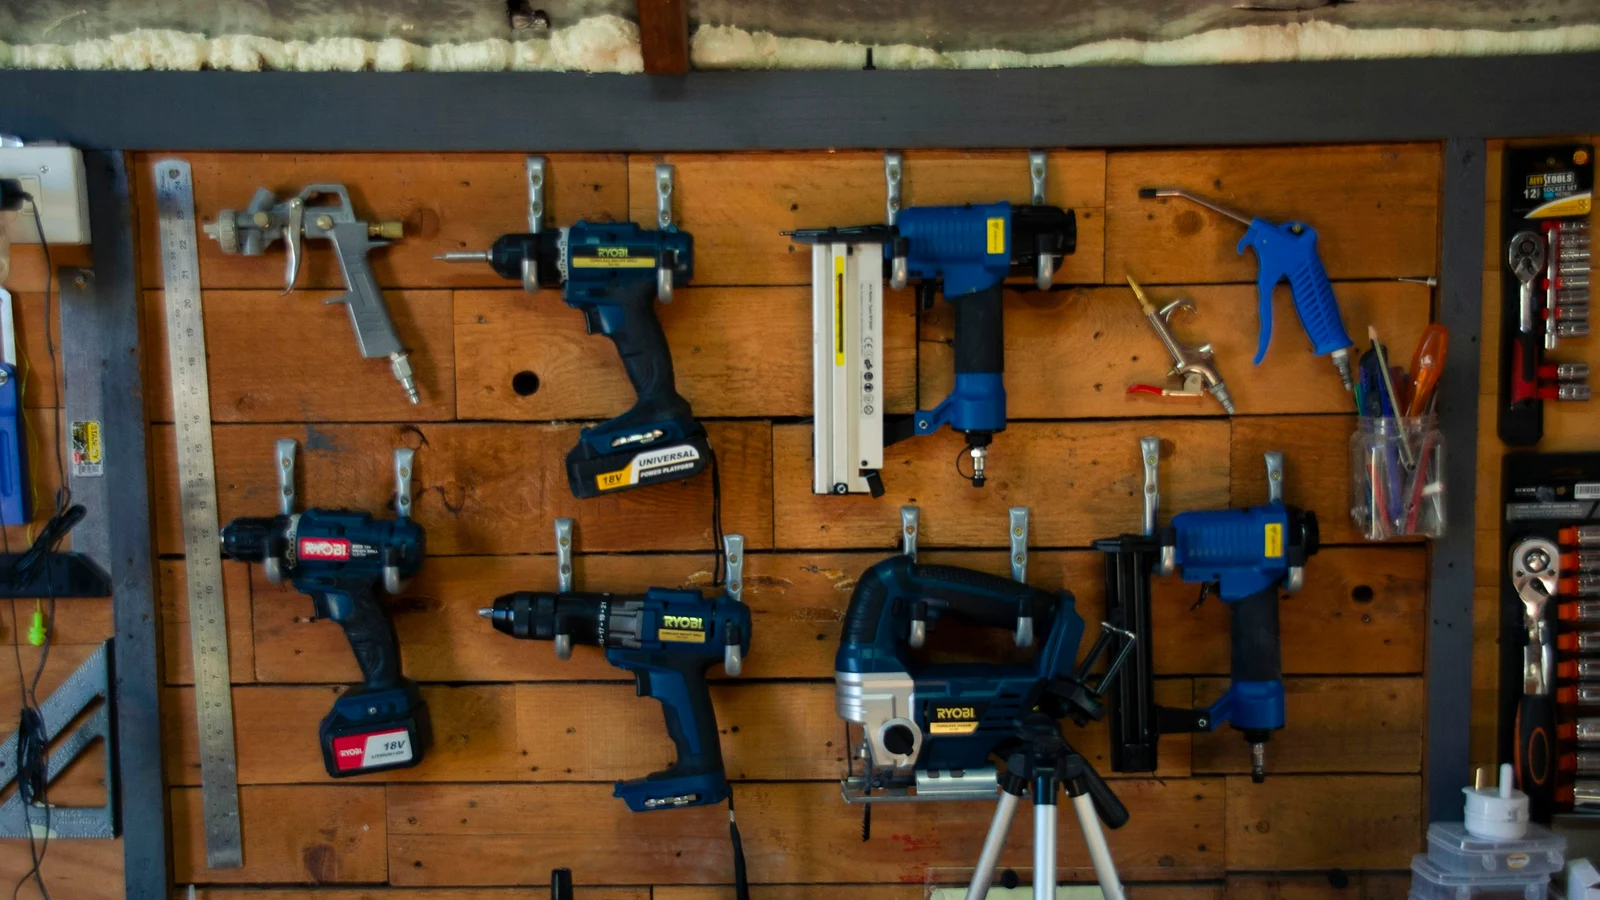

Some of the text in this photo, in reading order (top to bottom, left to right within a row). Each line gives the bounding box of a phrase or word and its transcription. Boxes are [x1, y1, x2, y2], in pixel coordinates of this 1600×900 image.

[1547, 174, 1572, 184] TOOLS
[175, 181, 182, 191] 24
[1524, 189, 1537, 198] 12
[180, 240, 186, 250] 22
[597, 246, 629, 258] RYOBI
[182, 270, 189, 280] 21
[184, 299, 192, 308] 20
[187, 328, 194, 337] 19
[188, 357, 196, 366] 18
[191, 386, 198, 395] 17
[194, 415, 200, 424] 16
[195, 443, 202, 453] 15
[639, 450, 695, 466] UNIVERSAL
[640, 462, 694, 478] POWER PLATFORM
[198, 472, 204, 482] 14
[603, 474, 622, 485] 18V
[200, 500, 207, 510] 13
[202, 529, 208, 538] 12
[304, 542, 348, 556] RYOBI
[204, 557, 211, 566] 11
[206, 586, 213, 595] 10
[663, 615, 703, 628] RYOBI
[936, 708, 974, 718] RYOBI
[384, 740, 406, 750] 18V
[340, 748, 362, 757] RYOBI
